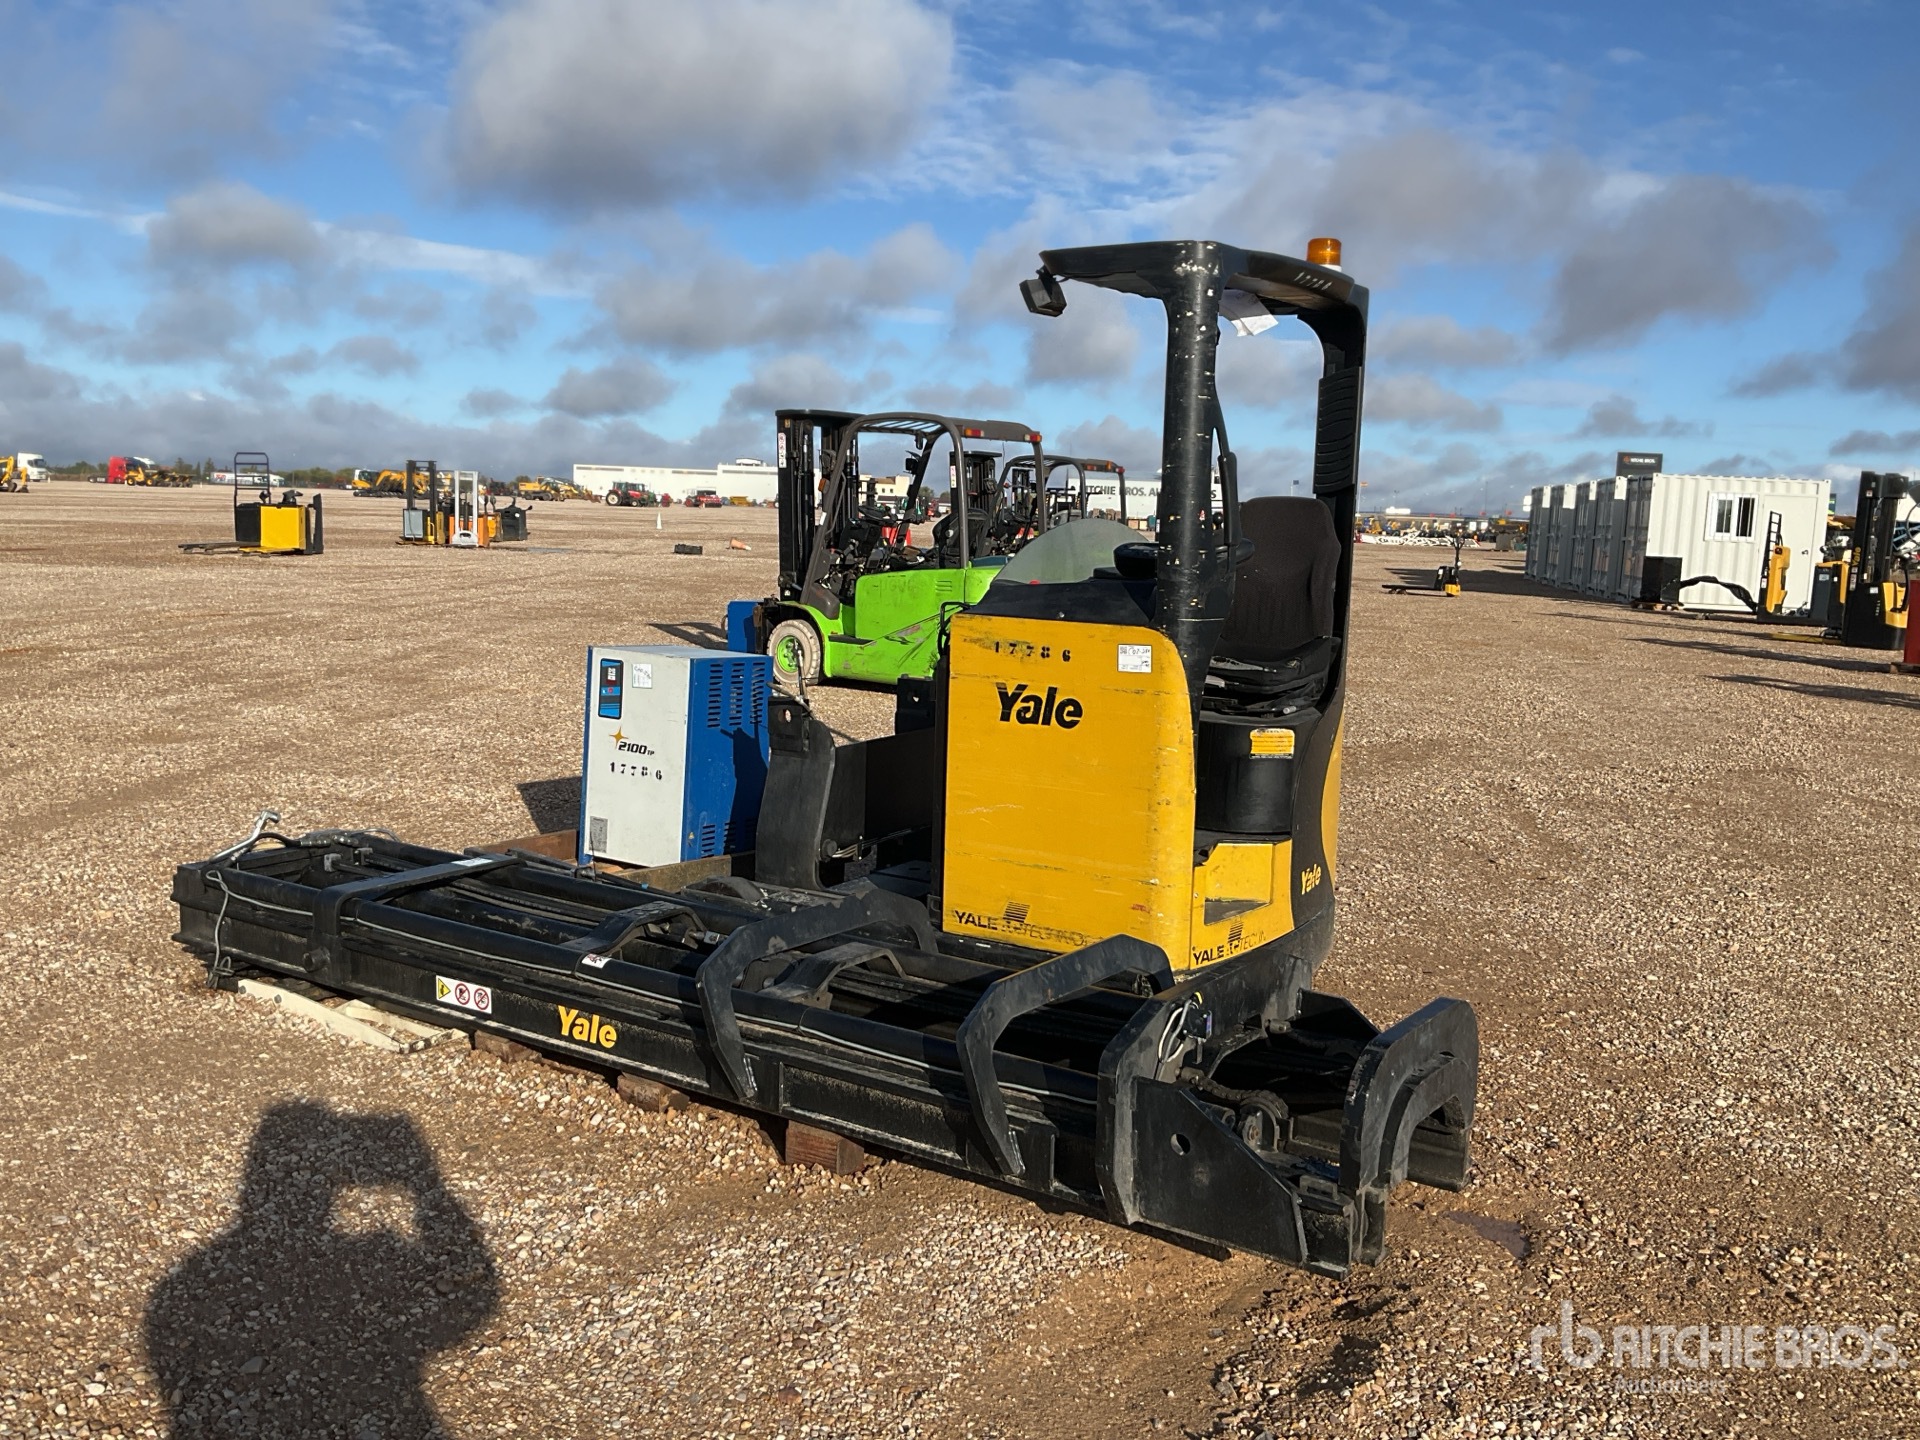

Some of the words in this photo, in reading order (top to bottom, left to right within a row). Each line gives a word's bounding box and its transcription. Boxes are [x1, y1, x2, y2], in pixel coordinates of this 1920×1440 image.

[994, 641, 1072, 662] 17786
[995, 682, 1083, 729] Yale
[610, 761, 663, 781] 17786
[1301, 863, 1322, 895] Yale
[954, 910, 999, 931] YALE
[1192, 944, 1225, 966] YALE
[558, 1005, 618, 1049] Yale
